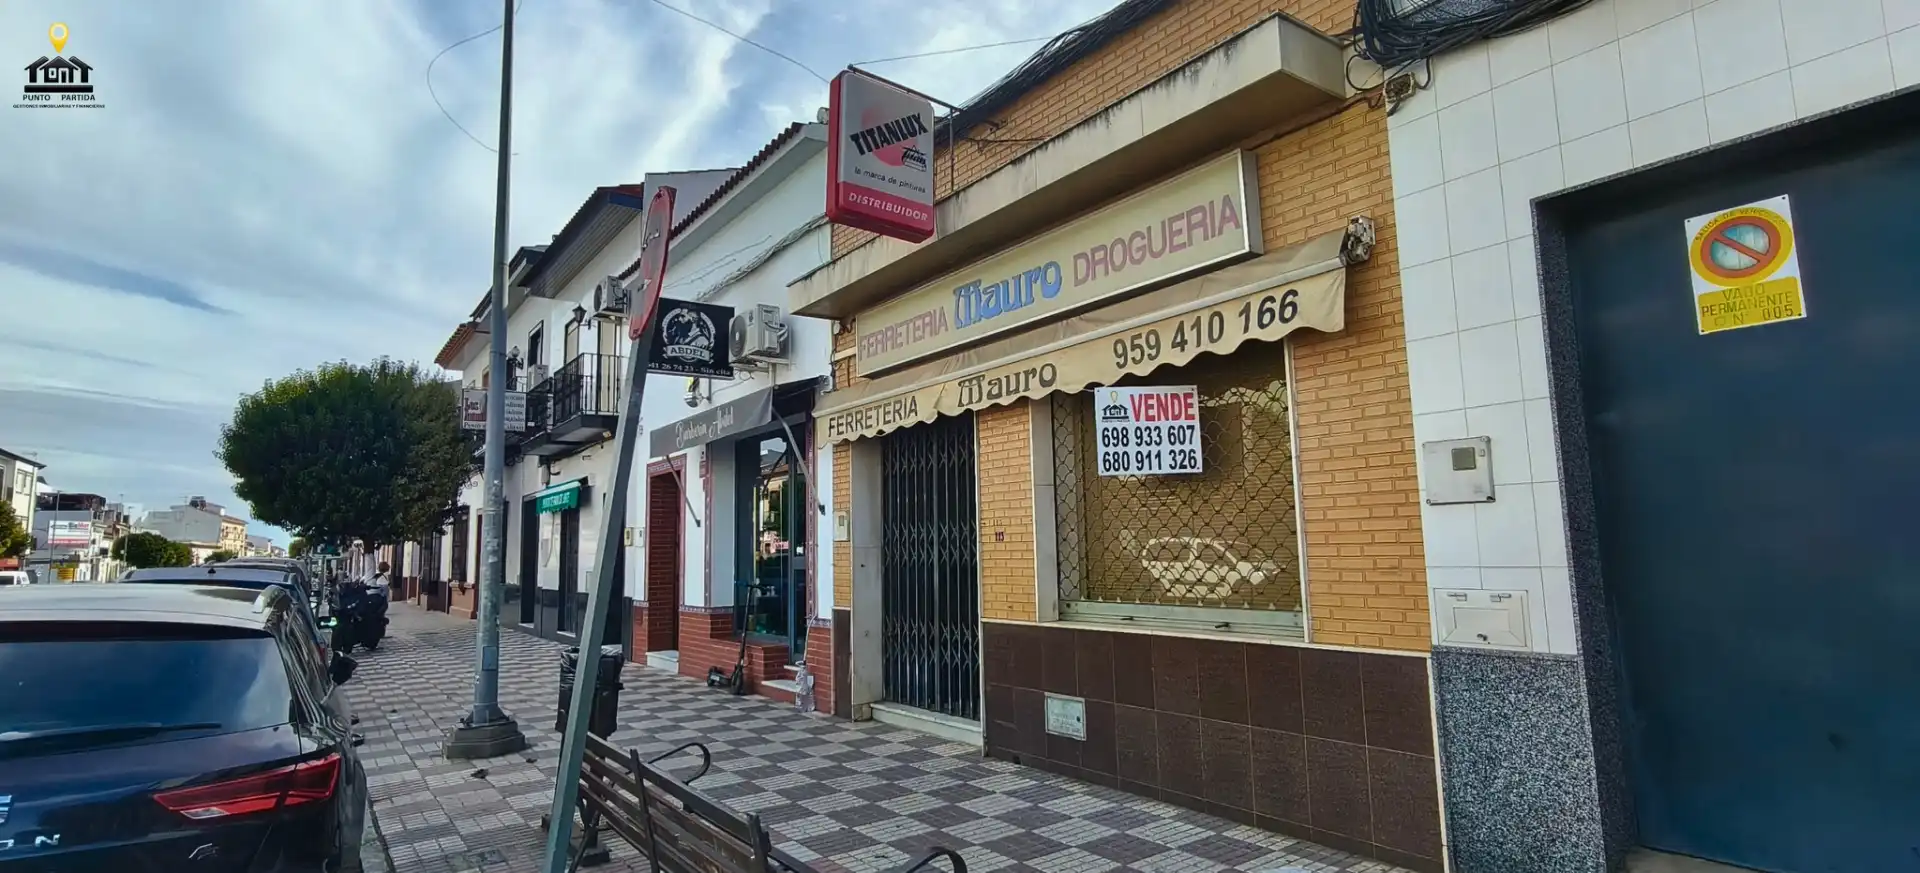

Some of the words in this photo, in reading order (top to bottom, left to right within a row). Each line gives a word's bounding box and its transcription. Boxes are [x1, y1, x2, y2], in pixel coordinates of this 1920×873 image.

[849, 112, 928, 156] TITANLUX
[854, 166, 861, 175] la
[863, 170, 886, 182] marca
[888, 176, 897, 185] de
[899, 180, 926, 194] pinturas
[849, 192, 928, 221] DISTRIBUIDOR
[859, 306, 948, 361] FERRETERIA
[953, 260, 1062, 329] Mauro
[1073, 194, 1241, 287] DROGUERIA
[1701, 291, 1793, 318] PERMANENTE
[1722, 282, 1766, 301] VADO
[1762, 304, 1794, 321] 005
[670, 347, 705, 359] ABDEL
[828, 395, 918, 438] FERRETERIA
[957, 362, 1057, 408] Mauro
[1113, 328, 1161, 369] 959
[1171, 310, 1224, 352] 410
[1238, 289, 1299, 335] 166
[716, 368, 730, 376] cita
[1129, 392, 1196, 422] VENDE
[1102, 426, 1130, 448] 698
[1134, 425, 1163, 447] 933
[1167, 424, 1195, 446] 607
[1102, 450, 1130, 472] 680
[1135, 449, 1162, 471] 911
[1168, 448, 1197, 470] 326
